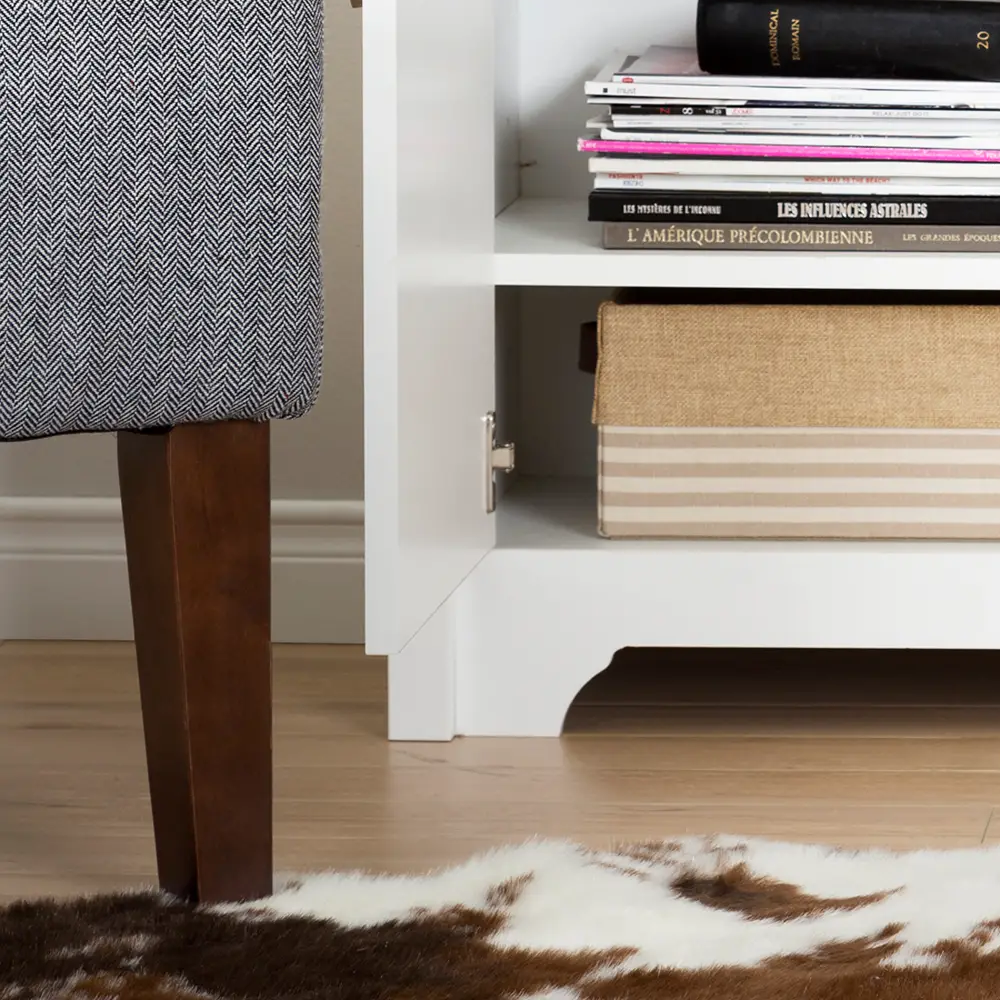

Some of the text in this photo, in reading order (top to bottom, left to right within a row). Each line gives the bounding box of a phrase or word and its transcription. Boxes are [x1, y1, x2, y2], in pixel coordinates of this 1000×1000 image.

[769, 8, 780, 66] DOMINICAL
[791, 18, 801, 61] ROMAIN
[976, 30, 990, 50] 20
[622, 204, 636, 214] LES
[637, 203, 672, 214] MYSTÈRES
[673, 205, 683, 214] DE
[776, 202, 929, 219] LES INFLUENCES ASTRALES
[729, 225, 874, 244] PRÉCOLOMBIENNE
[902, 233, 917, 241] LES
[920, 233, 960, 242] GRANDES
